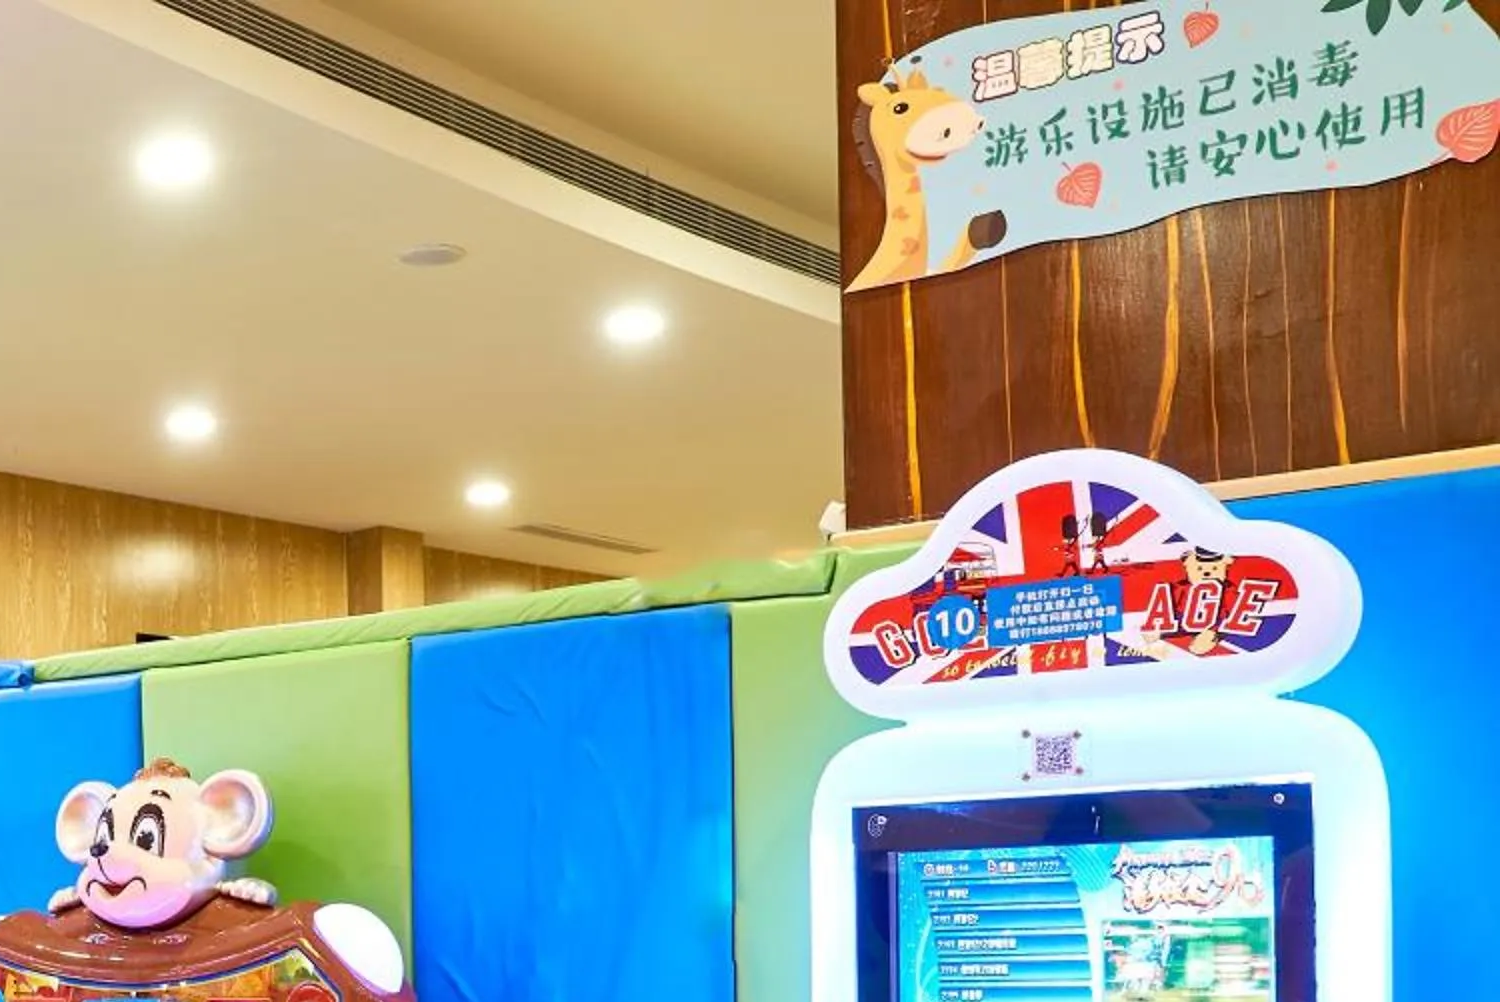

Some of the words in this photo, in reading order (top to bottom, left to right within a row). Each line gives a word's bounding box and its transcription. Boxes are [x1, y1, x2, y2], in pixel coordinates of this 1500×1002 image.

[972, 12, 1165, 102] 温馨提示
[983, 39, 1359, 168] 游乐设施已消毒
[1148, 87, 1425, 190] 请安心使用
[935, 608, 975, 638] 10
[1142, 579, 1279, 635] AGE
